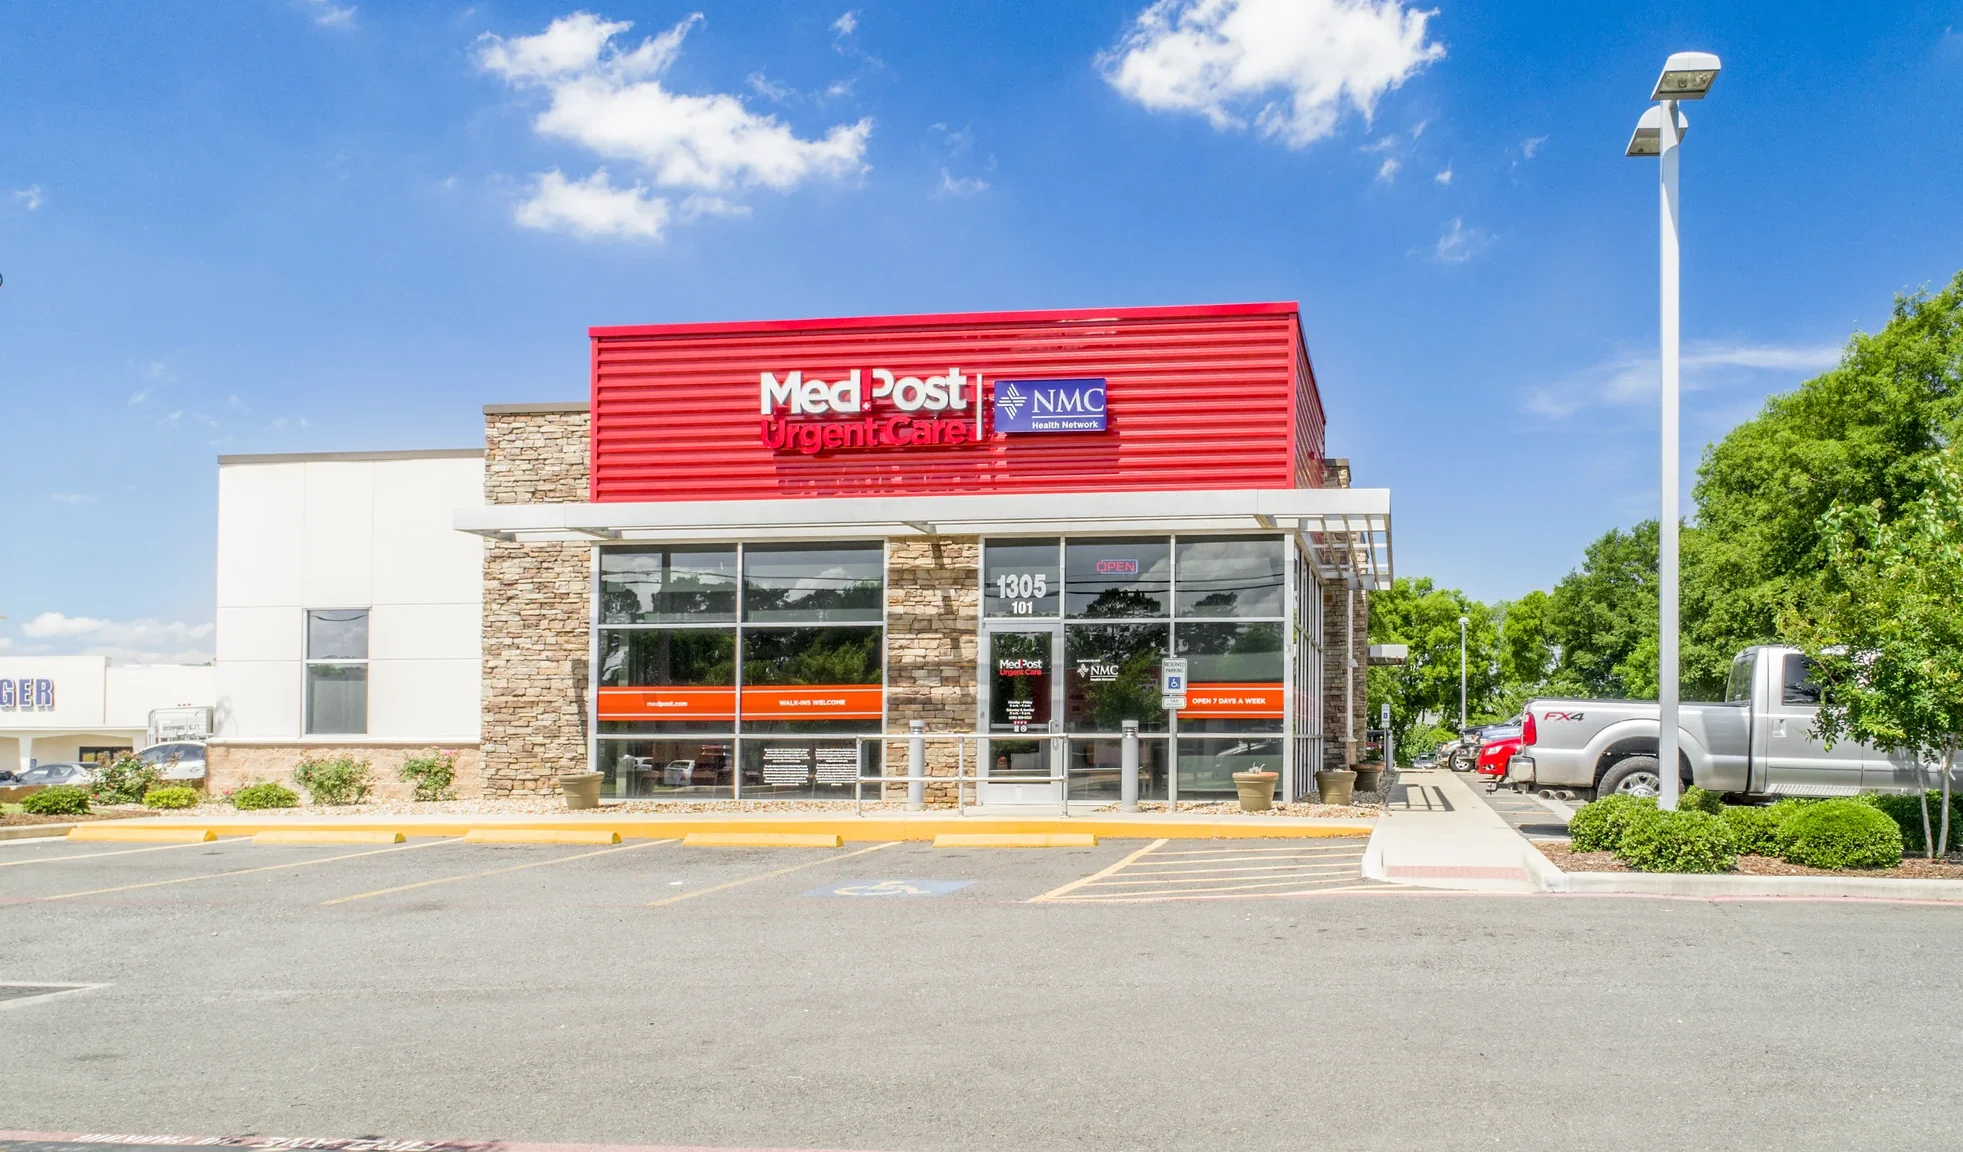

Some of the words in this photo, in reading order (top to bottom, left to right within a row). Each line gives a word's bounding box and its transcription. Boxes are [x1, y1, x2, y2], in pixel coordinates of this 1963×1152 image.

[1031, 387, 1105, 413] NMC
[1031, 420, 1060, 430] Health
[1061, 420, 1099, 430] Network
[760, 416, 878, 454] Urgent
[885, 416, 968, 446] Care
[1096, 561, 1136, 573] OPEN
[996, 574, 1047, 599] 1305
[1011, 601, 1033, 615] 101
[999, 668, 1024, 677] Urgent
[1024, 668, 1043, 676] Care
[1090, 664, 1119, 676] NMC
[1191, 697, 1212, 705] OPEN
[1212, 697, 1217, 705] 7
[1218, 697, 1237, 705] DAYS
[1244, 697, 1266, 705] WEEK
[1544, 711, 1585, 721] FX4
